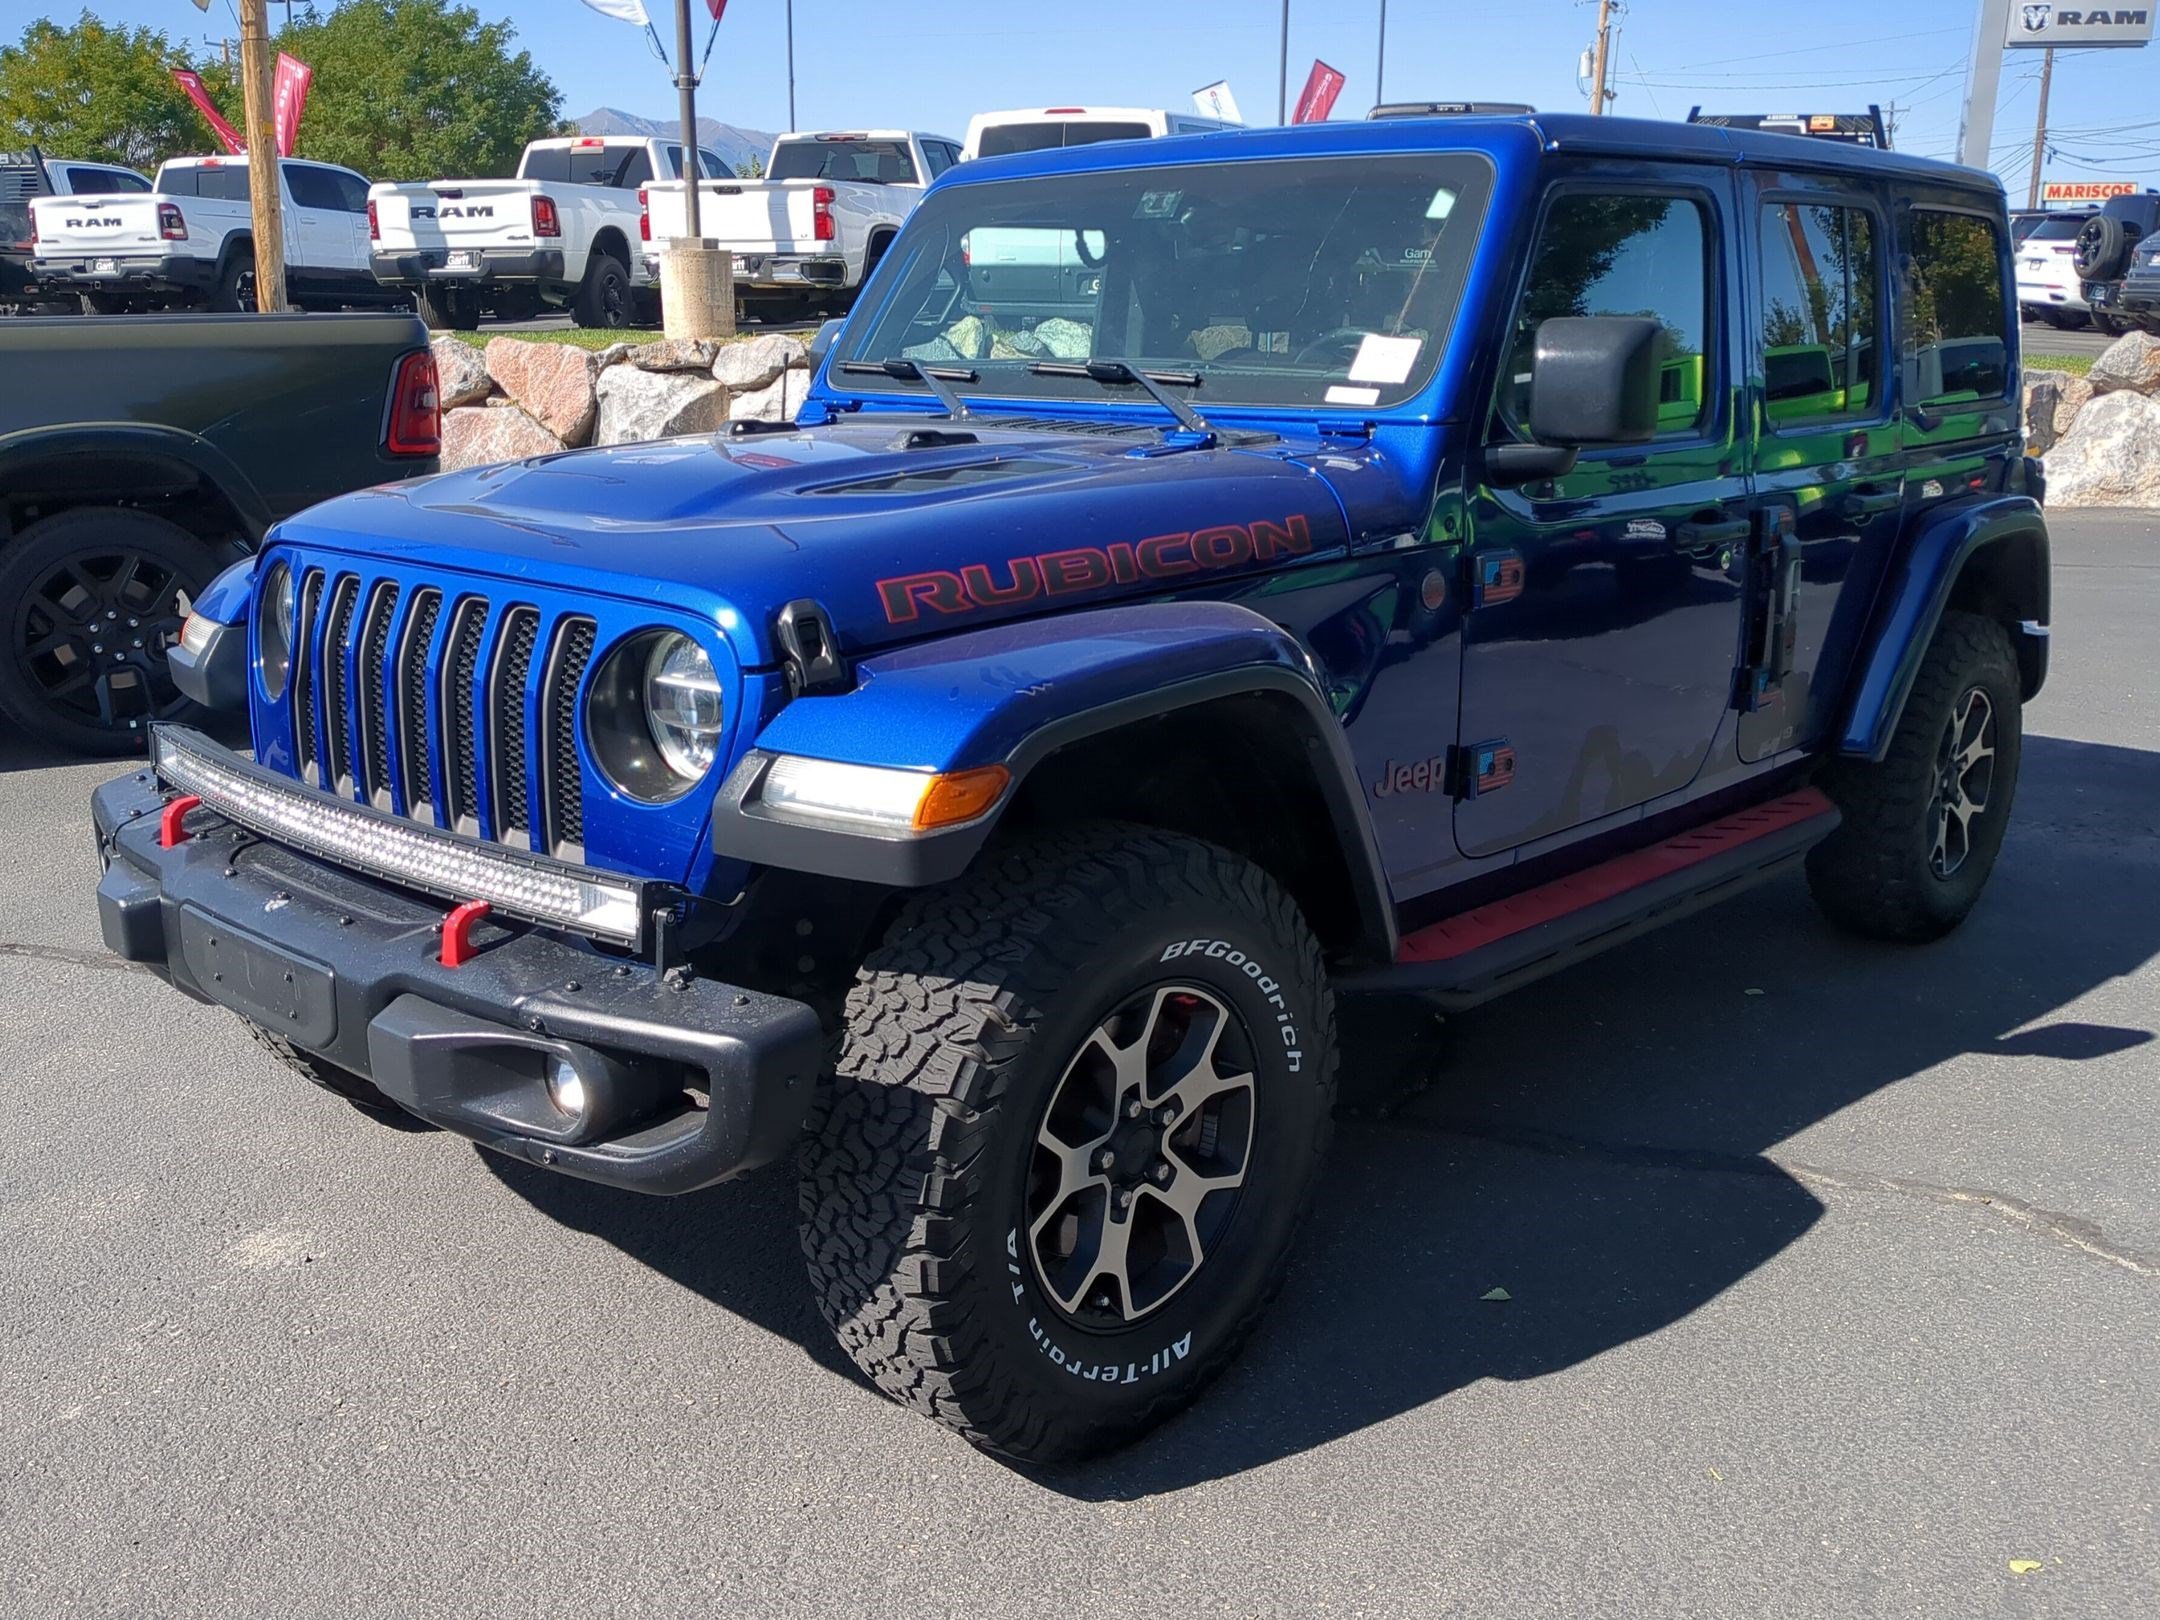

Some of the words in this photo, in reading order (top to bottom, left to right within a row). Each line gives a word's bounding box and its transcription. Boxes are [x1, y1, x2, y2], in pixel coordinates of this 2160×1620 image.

[2057, 10, 2147, 25] RAM
[2047, 185, 2133, 199] MARISCOS
[66, 218, 122, 228] RAM
[410, 206, 494, 219] RAM
[876, 515, 1311, 623] RUBICON
[1374, 755, 1446, 799] Jeep
[1160, 939, 1301, 1072] BFGoodrich
[1028, 1317, 1191, 1384] All-Terrain
